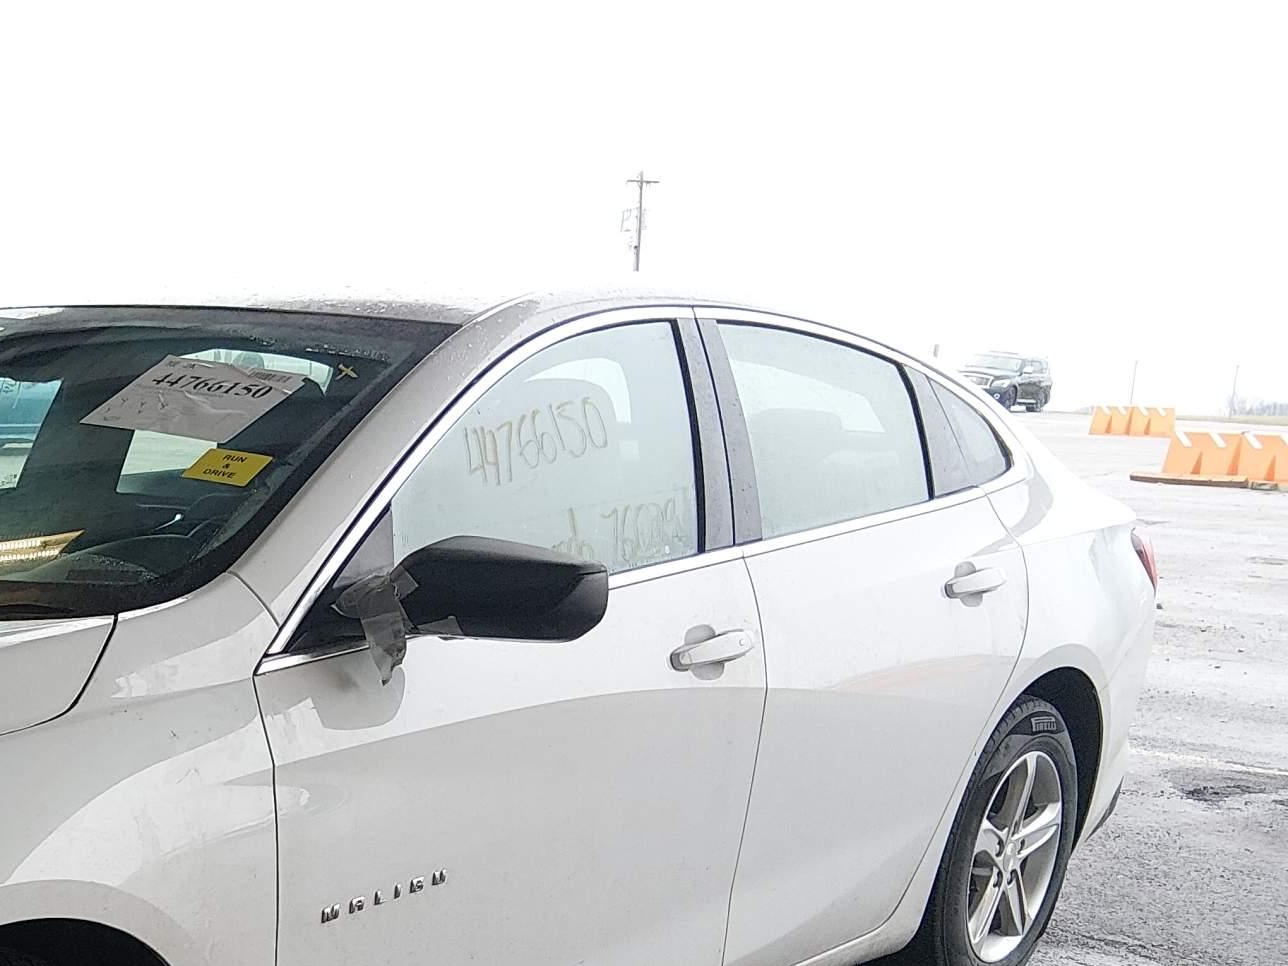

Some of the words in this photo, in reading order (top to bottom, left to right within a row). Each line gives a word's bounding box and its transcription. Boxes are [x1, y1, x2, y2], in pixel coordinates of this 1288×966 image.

[152, 371, 273, 400] 44766150
[462, 396, 609, 486] 44766150
[222, 453, 248, 463] RUN
[202, 469, 237, 480] DRIVE
[320, 868, 448, 924] MALIBU
